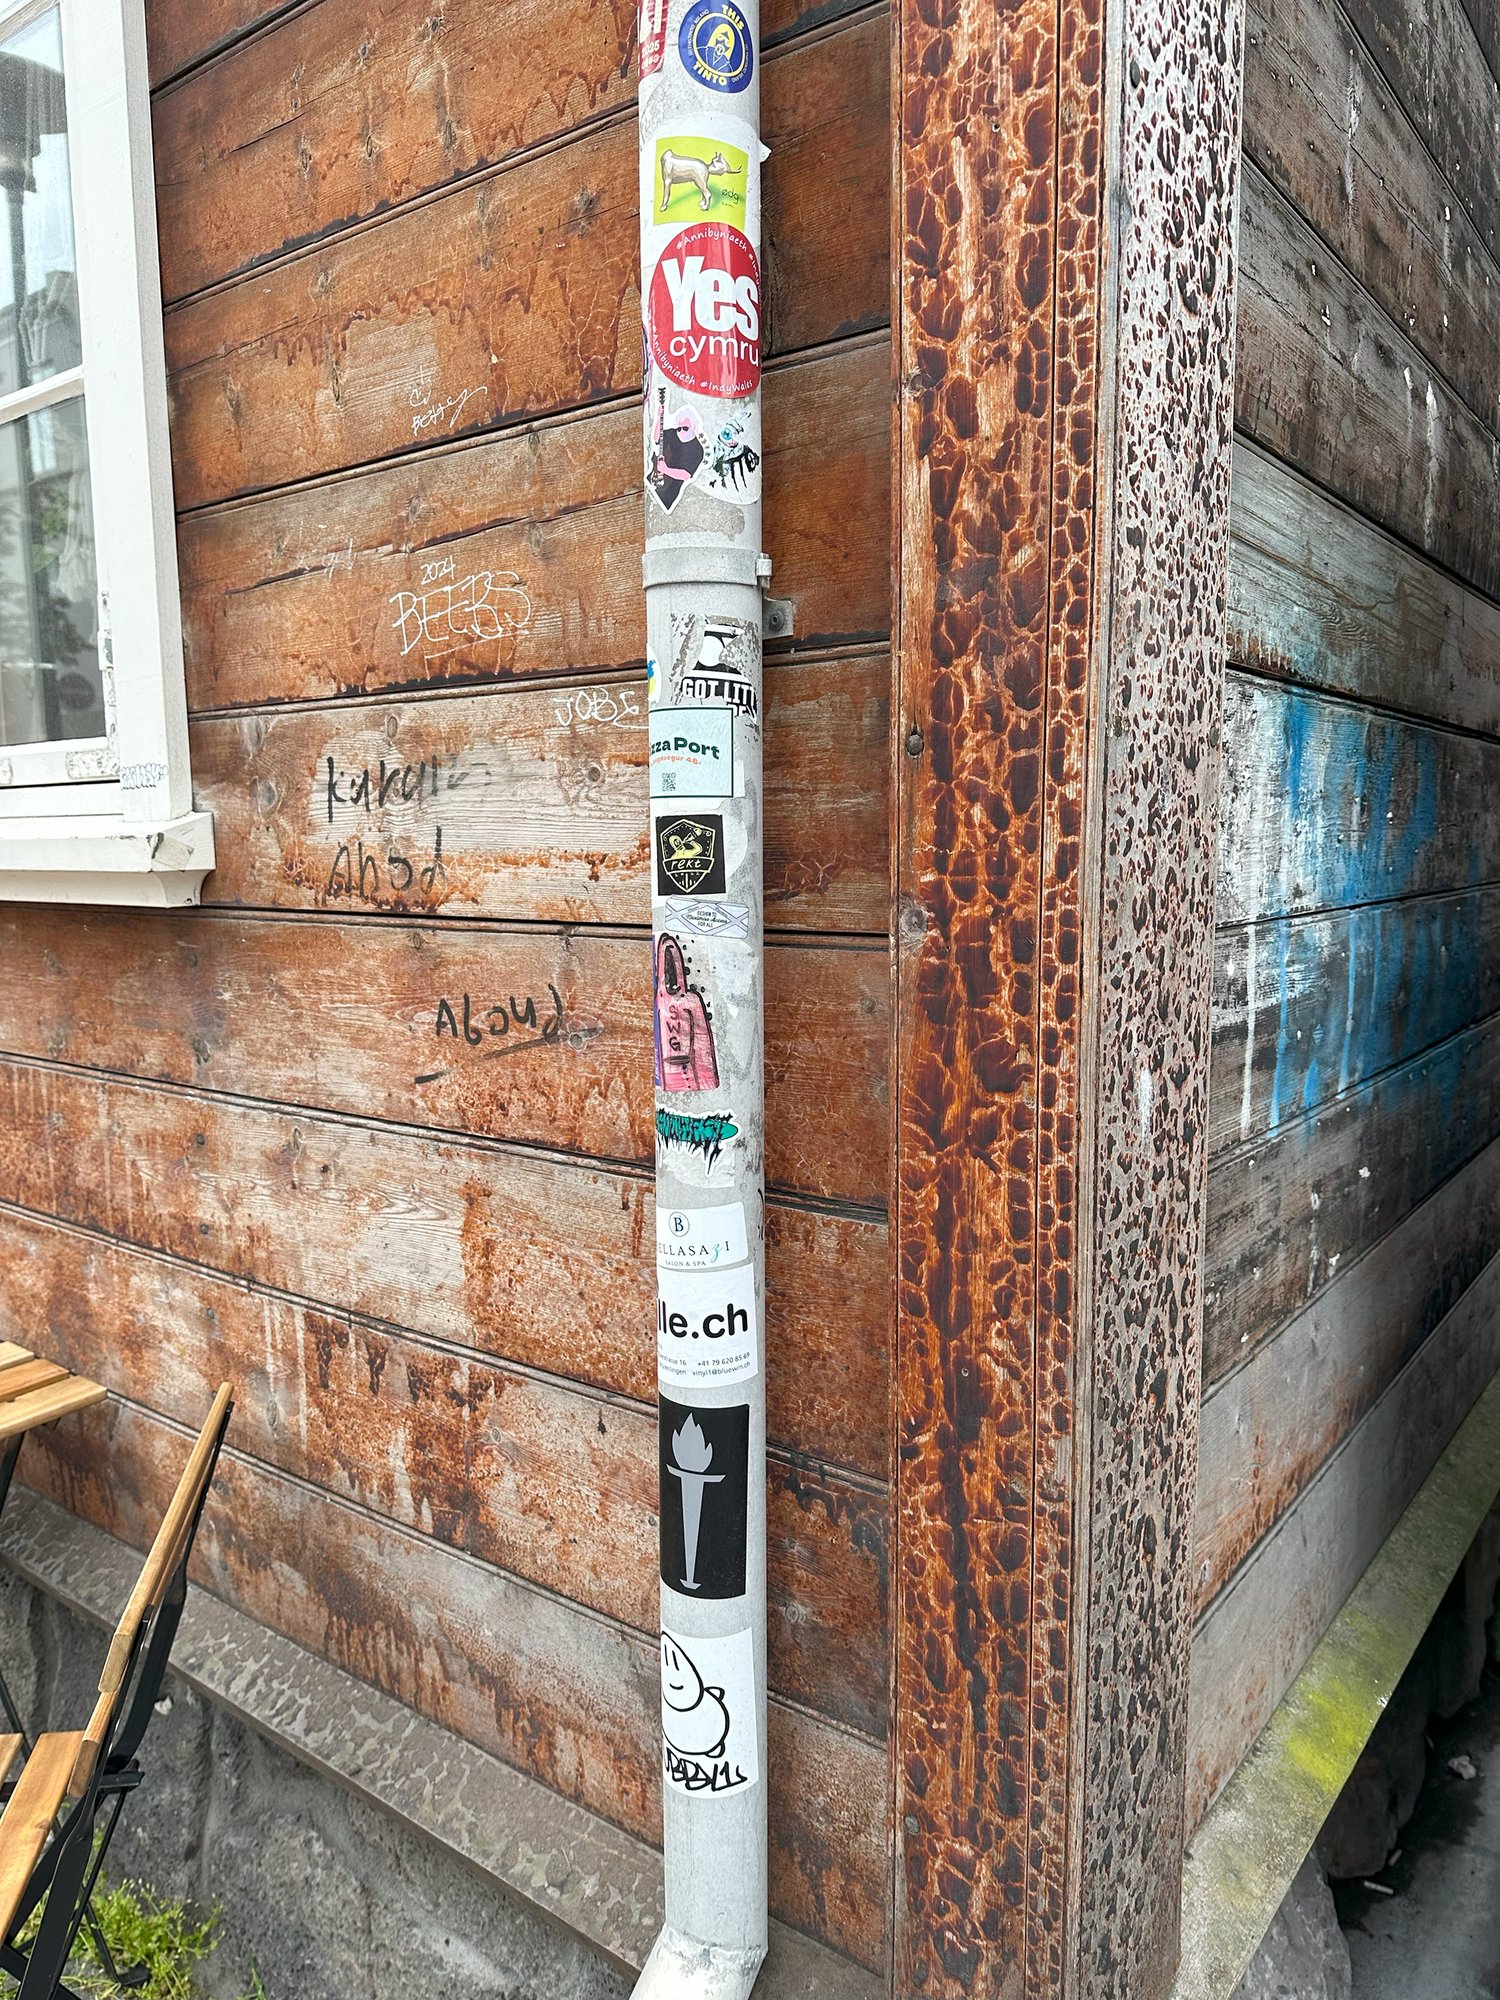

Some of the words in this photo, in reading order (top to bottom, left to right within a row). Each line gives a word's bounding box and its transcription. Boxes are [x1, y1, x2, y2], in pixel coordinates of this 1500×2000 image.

[721, 4, 745, 31] THIS
[693, 60, 727, 86] TINTO
[676, 227, 747, 251] #Annibyniaeth
[661, 255, 759, 341] Yes
[669, 335, 760, 368] cymru
[700, 379, 753, 393] #IndyWales
[682, 678, 719, 699] GOT
[650, 739, 671, 755] zza
[674, 736, 720, 760] Port
[670, 859, 702, 871] rekt
[673, 1217, 684, 1232] B
[658, 1298, 748, 1340] lle.ch
